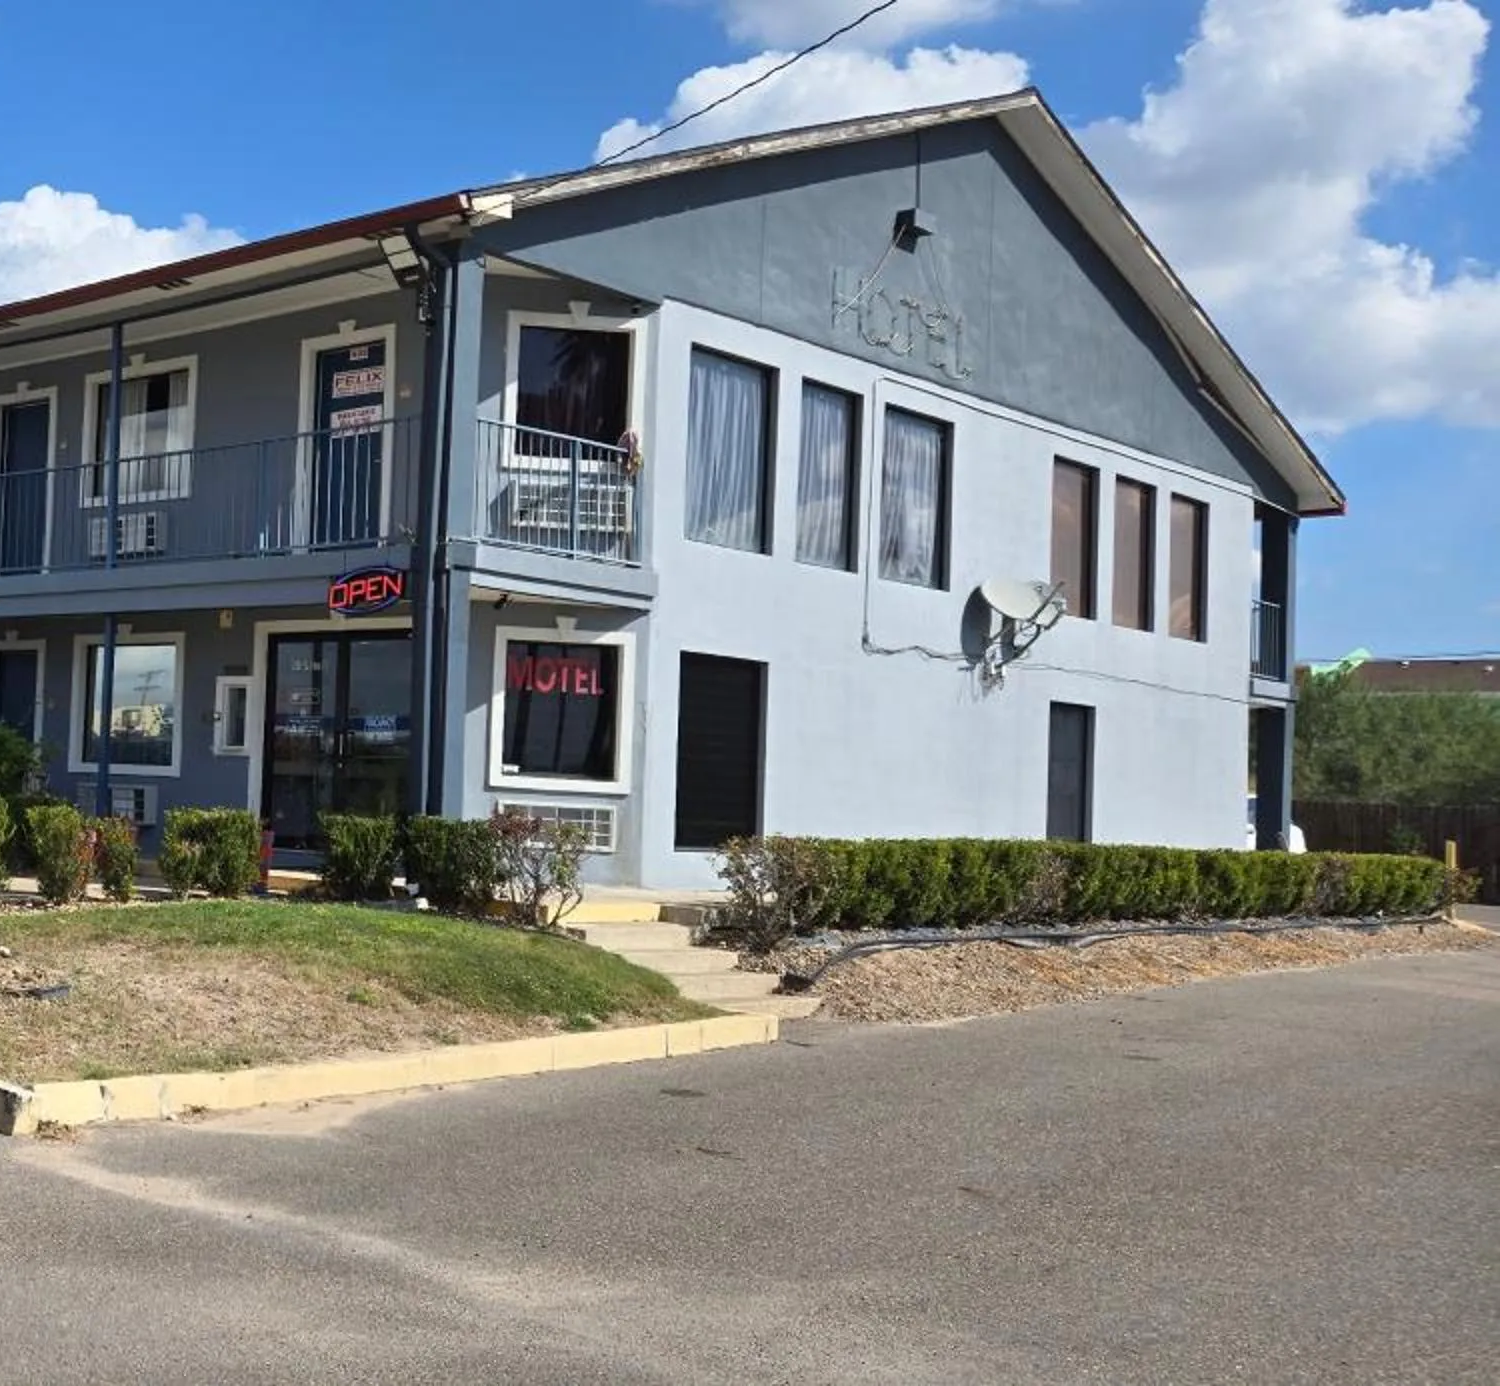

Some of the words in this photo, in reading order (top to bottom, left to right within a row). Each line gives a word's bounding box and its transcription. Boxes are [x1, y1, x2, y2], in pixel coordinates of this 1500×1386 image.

[336, 371, 382, 388] FELIX
[329, 572, 402, 609] OPEN
[506, 652, 605, 695] MOTEL
